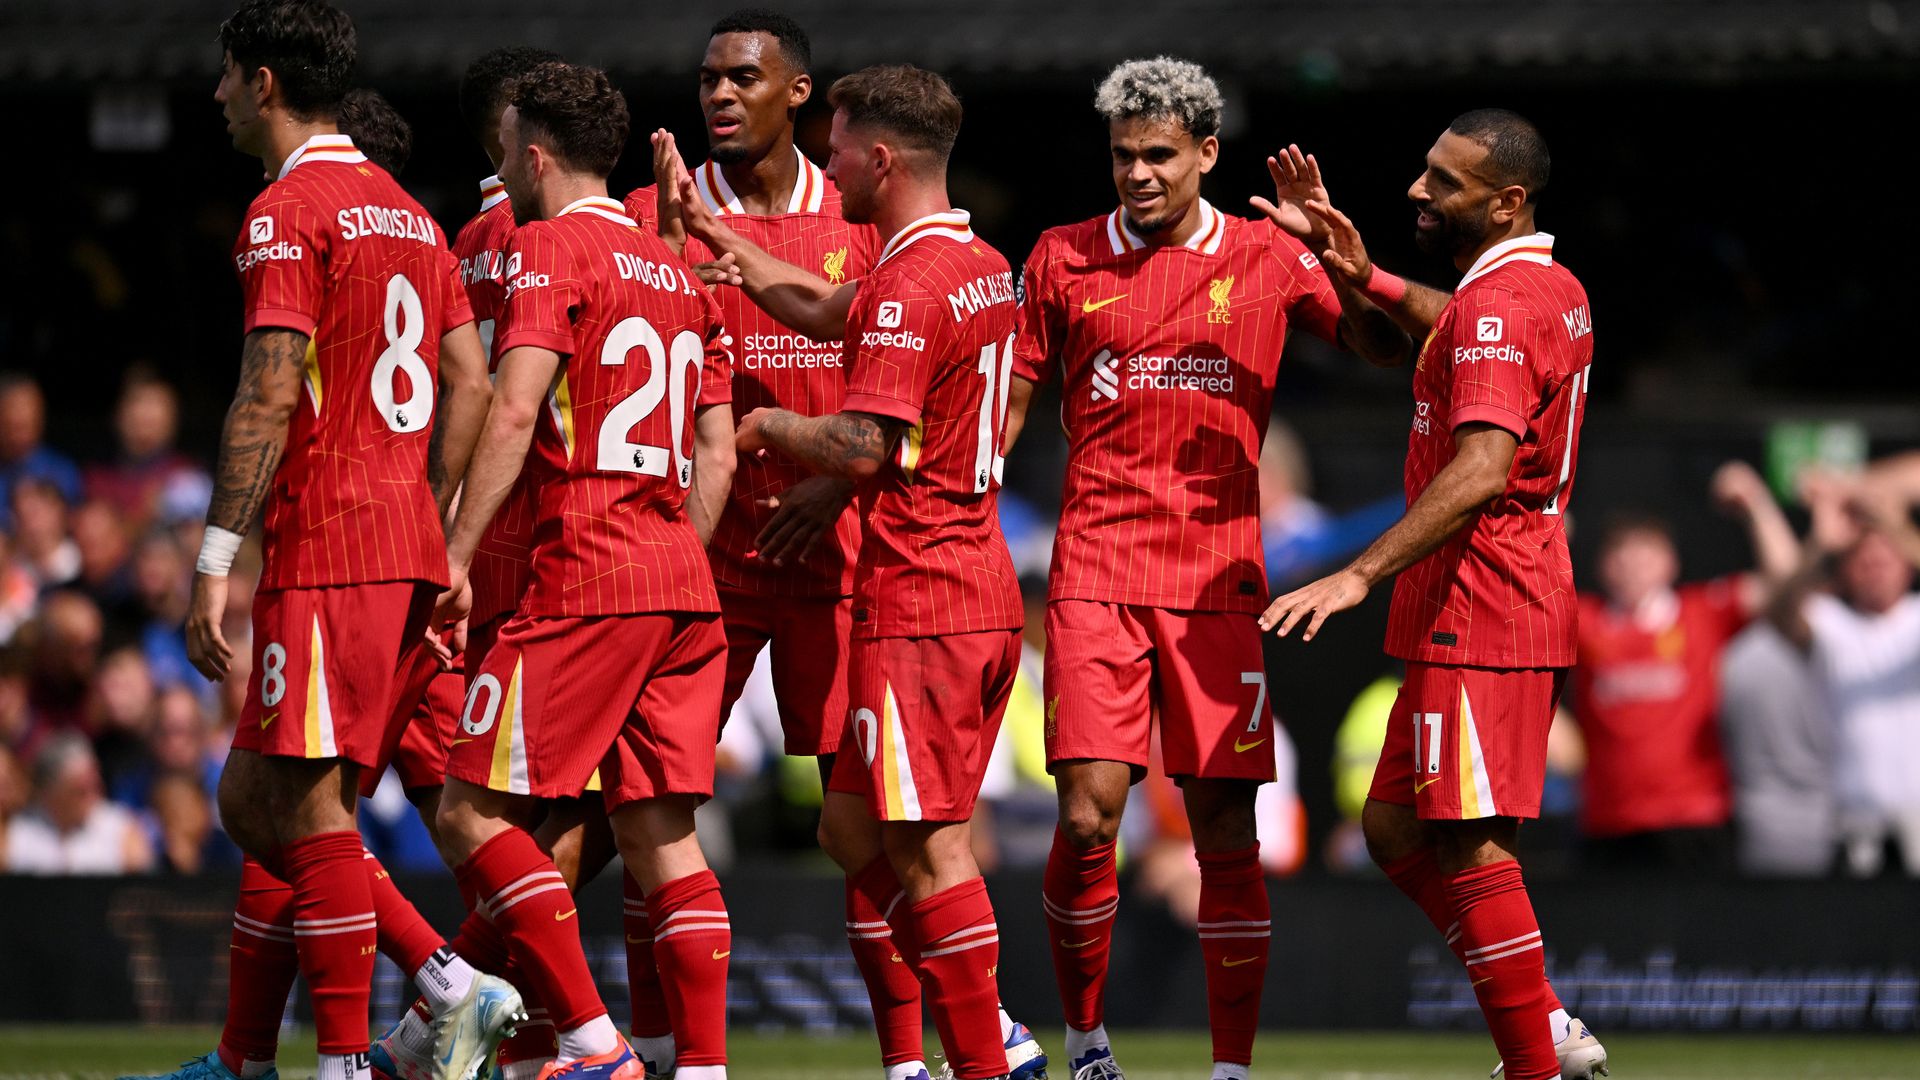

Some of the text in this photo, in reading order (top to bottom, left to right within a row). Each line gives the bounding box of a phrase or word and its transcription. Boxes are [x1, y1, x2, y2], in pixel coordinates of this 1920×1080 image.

[235, 241, 303, 273] Epedia
[612, 252, 677, 293] DIOGO
[370, 273, 434, 432] 8
[1128, 353, 1229, 374] standard
[1128, 372, 1234, 393] chartered
[1455, 344, 1525, 366] Expedia
[596, 316, 704, 489] 20
[261, 642, 287, 707] 8
[460, 672, 502, 736] 0
[1240, 671, 1266, 732] 7
[850, 707, 878, 771] 0
[1412, 712, 1443, 774] 11
